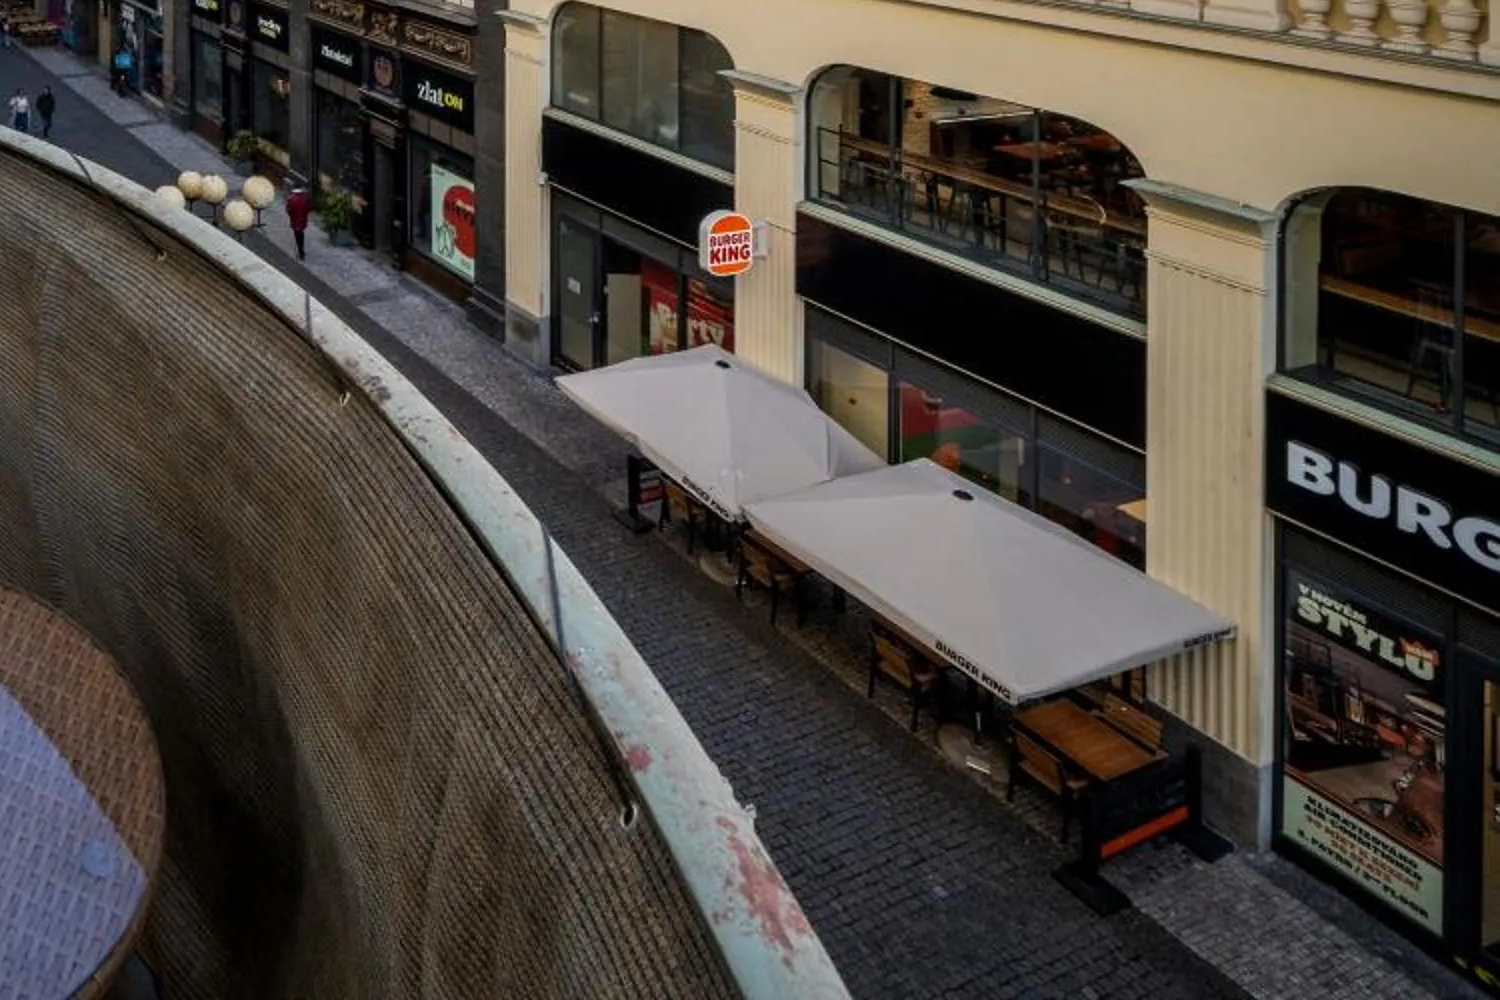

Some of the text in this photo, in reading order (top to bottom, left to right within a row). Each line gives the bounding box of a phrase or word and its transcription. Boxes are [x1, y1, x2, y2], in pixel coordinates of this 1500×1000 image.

[710, 232, 750, 246] BURGER
[710, 244, 750, 264] KING
[935, 640, 1011, 700] BURGER KING
